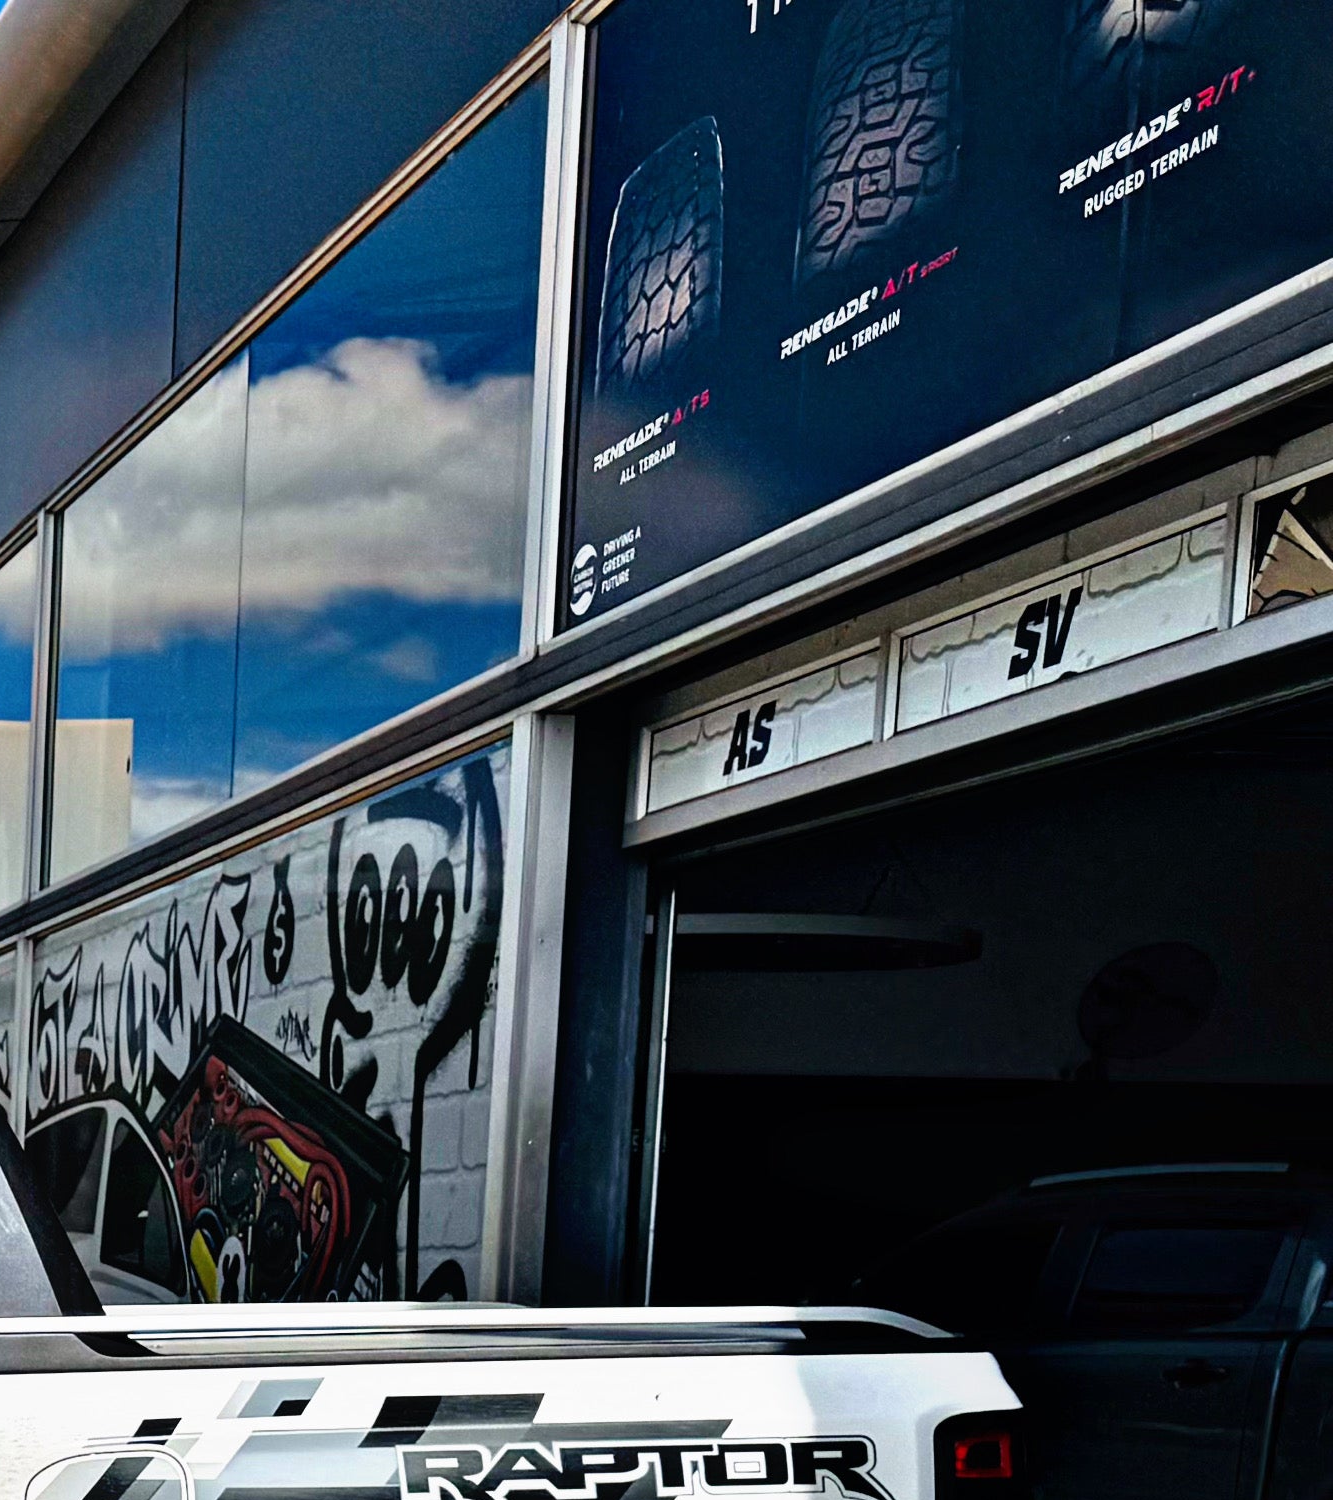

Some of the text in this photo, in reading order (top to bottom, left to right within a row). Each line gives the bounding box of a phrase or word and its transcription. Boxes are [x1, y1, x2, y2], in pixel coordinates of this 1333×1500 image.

[1084, 125, 1218, 218] RUGGED TERRAIN
[826, 308, 901, 366] ALL TERRAIN
[619, 440, 676, 485] ALL TERRAIN
[1008, 586, 1083, 680] SV
[722, 701, 777, 776] AS
